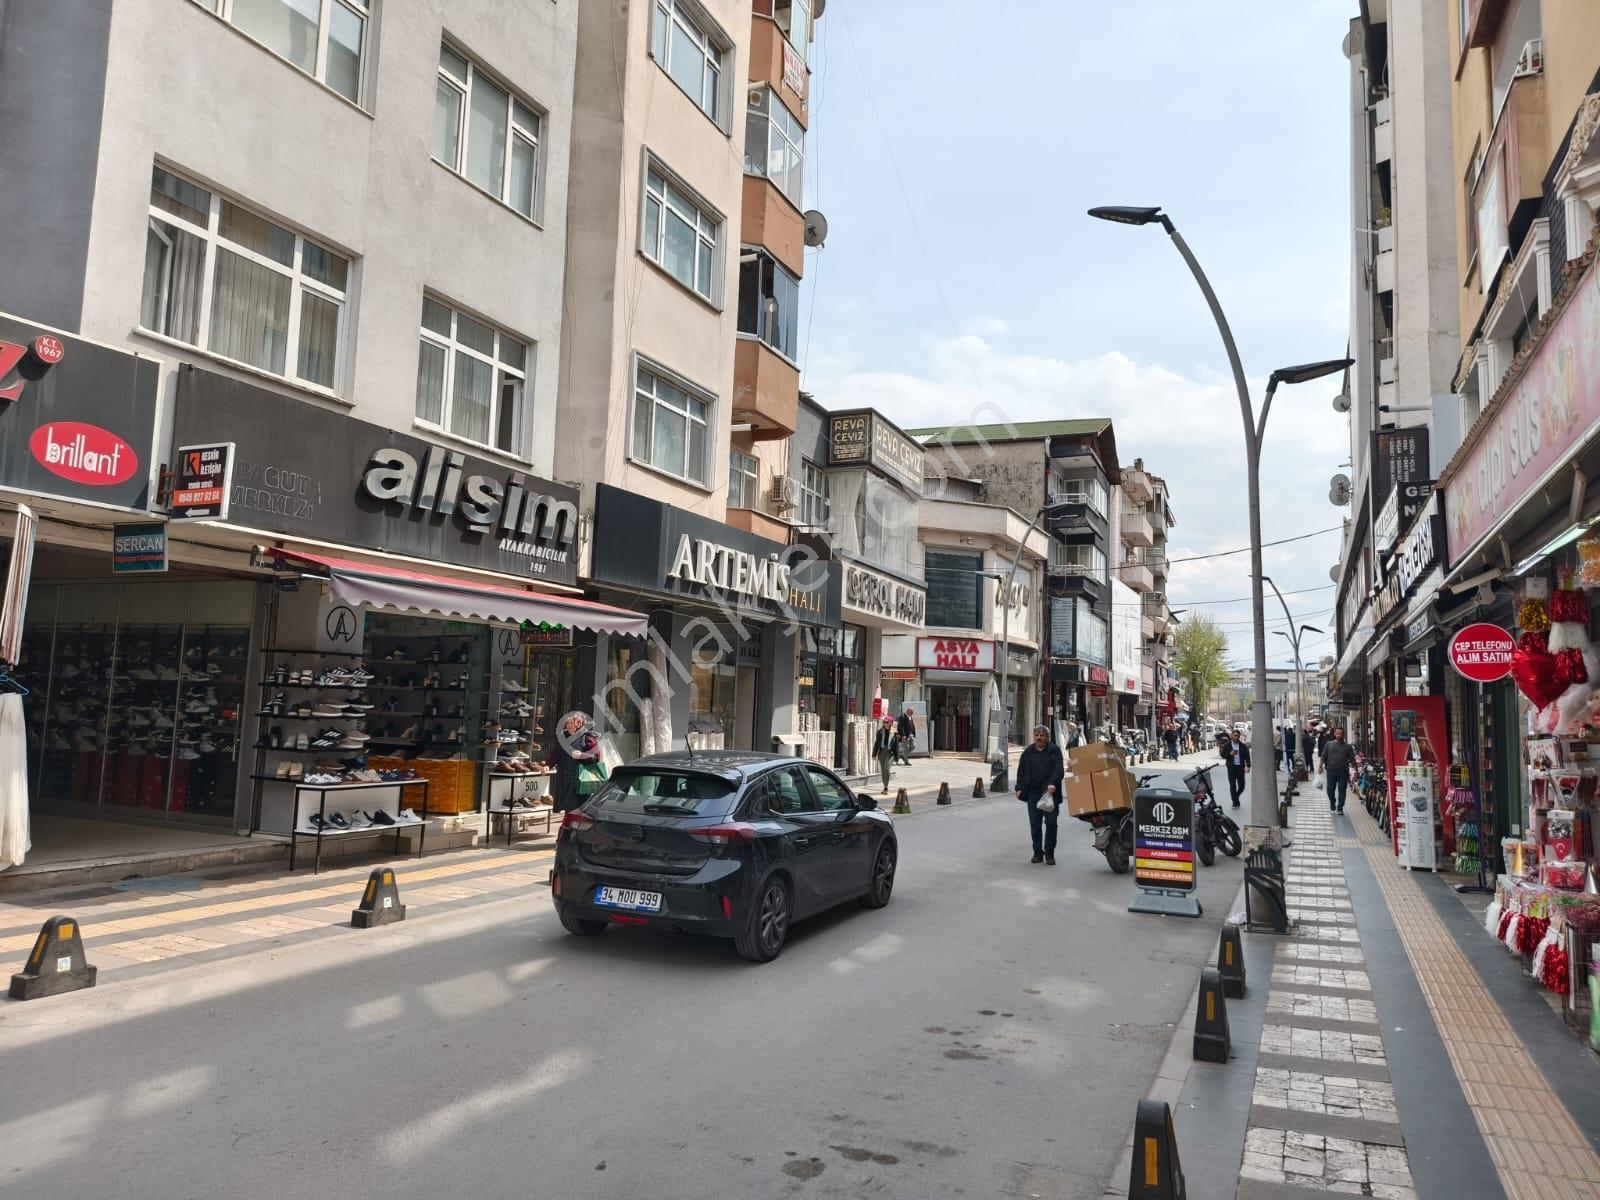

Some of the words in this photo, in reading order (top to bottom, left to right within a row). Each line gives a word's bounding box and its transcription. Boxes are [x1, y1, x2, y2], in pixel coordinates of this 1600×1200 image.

[42, 337, 58, 349] K.T.
[38, 344, 61, 358] 1967
[835, 419, 865, 430] REVA
[876, 423, 898, 458] REVA
[45, 426, 120, 477] brillant
[363, 445, 578, 545] alişim
[115, 537, 163, 552] SERCAN
[530, 562, 547, 573] 1981
[790, 586, 821, 613] HALI
[933, 640, 980, 654] ASYA
[1455, 642, 1470, 651] CEP
[1471, 641, 1512, 650] TELEFONU
[937, 654, 977, 669] HALI
[1457, 653, 1480, 663] ALIM
[1482, 652, 1512, 662] SATIM
[525, 781, 538, 792] 500
[1139, 824, 1171, 834] MERKEZ
[1171, 826, 1189, 836] GSM
[601, 888, 613, 901] 34
[639, 893, 658, 906] 999
